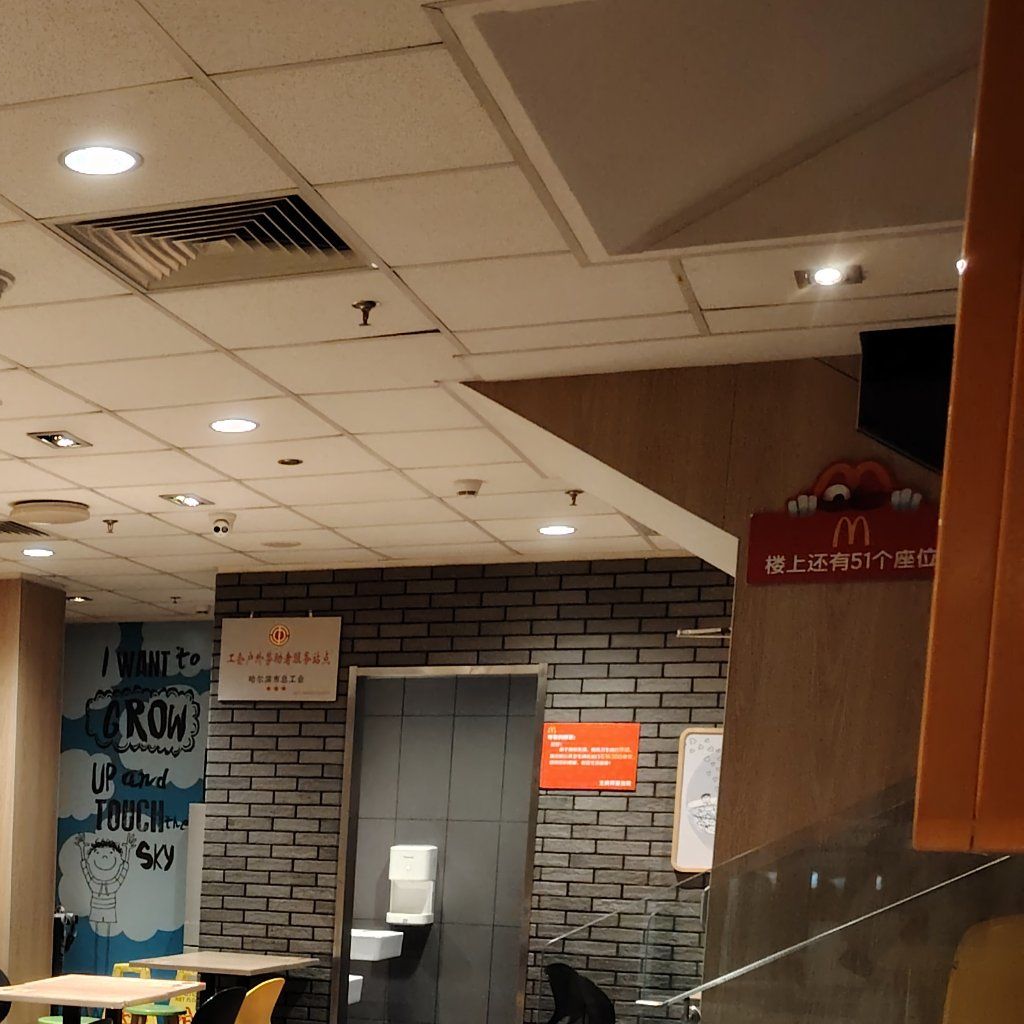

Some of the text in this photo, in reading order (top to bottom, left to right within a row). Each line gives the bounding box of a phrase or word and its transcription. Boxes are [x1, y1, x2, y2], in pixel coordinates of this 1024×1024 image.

[764, 547, 937, 576] 楼上还有51个座位
[101, 645, 201, 678] I WANT to
[102, 698, 188, 742] GROW
[91, 762, 169, 795] UP and
[95, 799, 188, 833] TOUCH the
[135, 841, 175, 871] SKY
